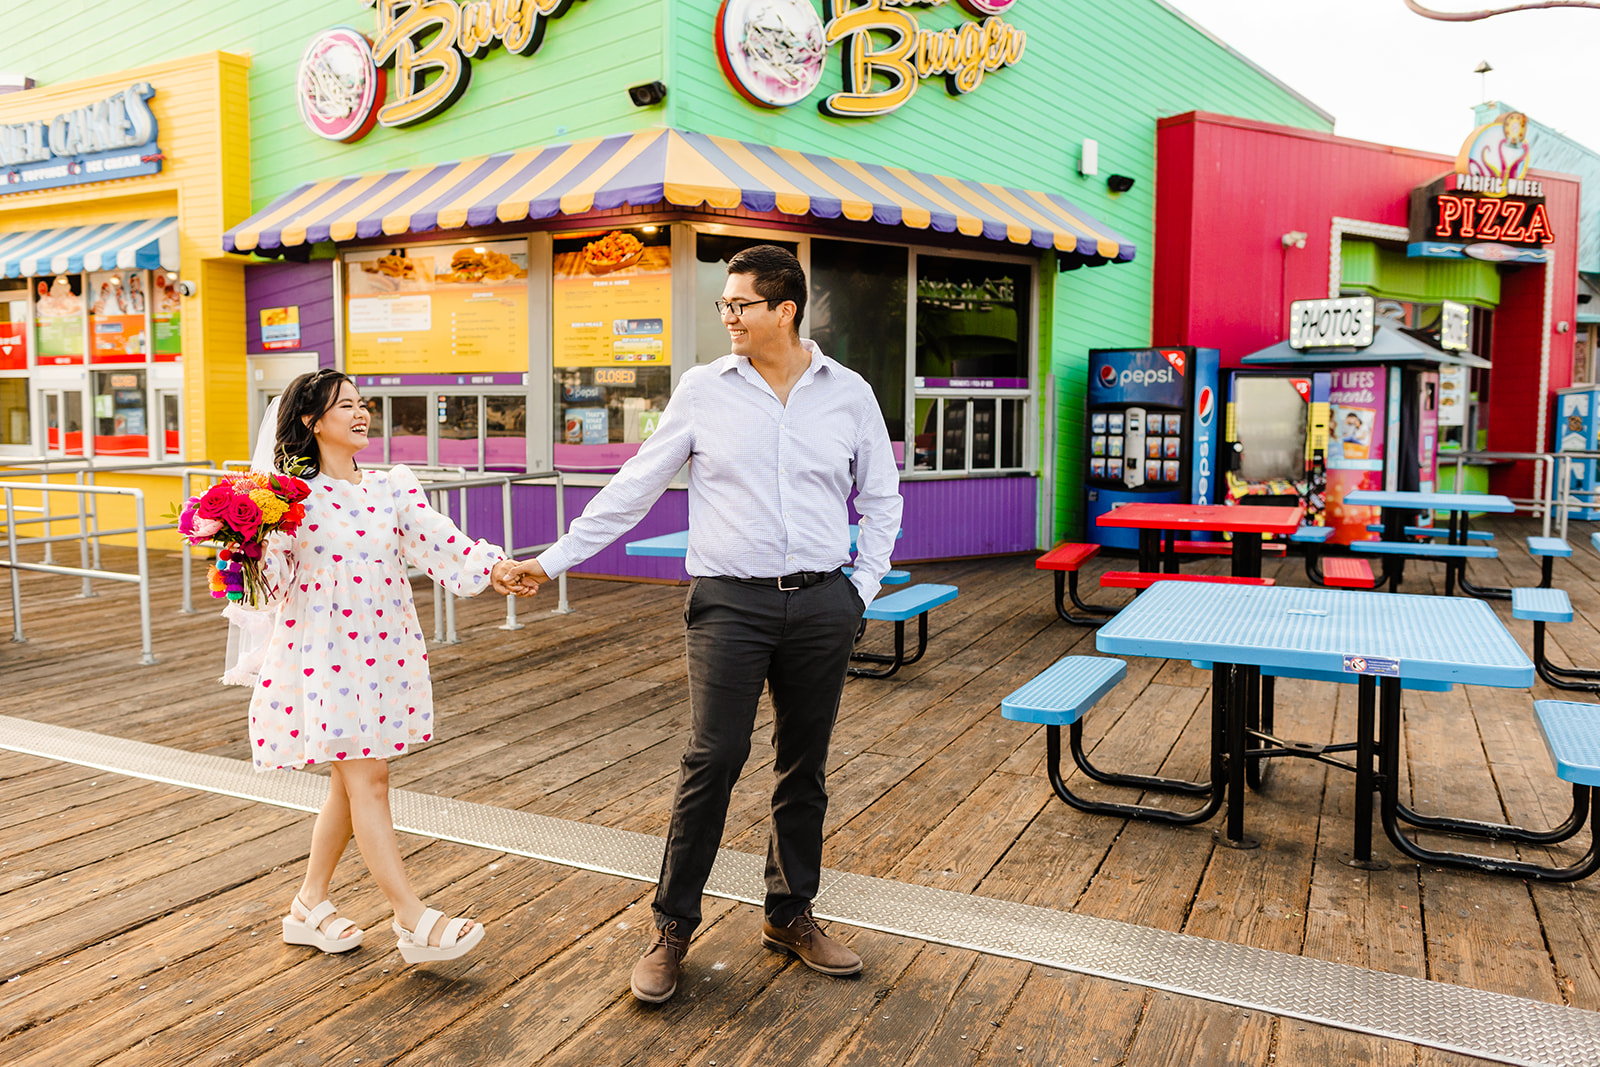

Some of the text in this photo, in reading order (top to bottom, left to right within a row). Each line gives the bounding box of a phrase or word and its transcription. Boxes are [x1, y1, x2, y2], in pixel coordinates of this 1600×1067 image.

[823, 5, 1026, 117] Burger
[49, 82, 156, 158] CAKES
[1457, 173, 1544, 197] PACIFIC WHEEL
[1436, 195, 1555, 243] PIZZA
[1299, 307, 1362, 338] PHOTOS
[595, 370, 637, 383] CLOSED
[1120, 366, 1173, 387] pepsi
[1342, 371, 1375, 388] LIFES
[575, 387, 598, 399] pepsi
[644, 418, 655, 434] A
